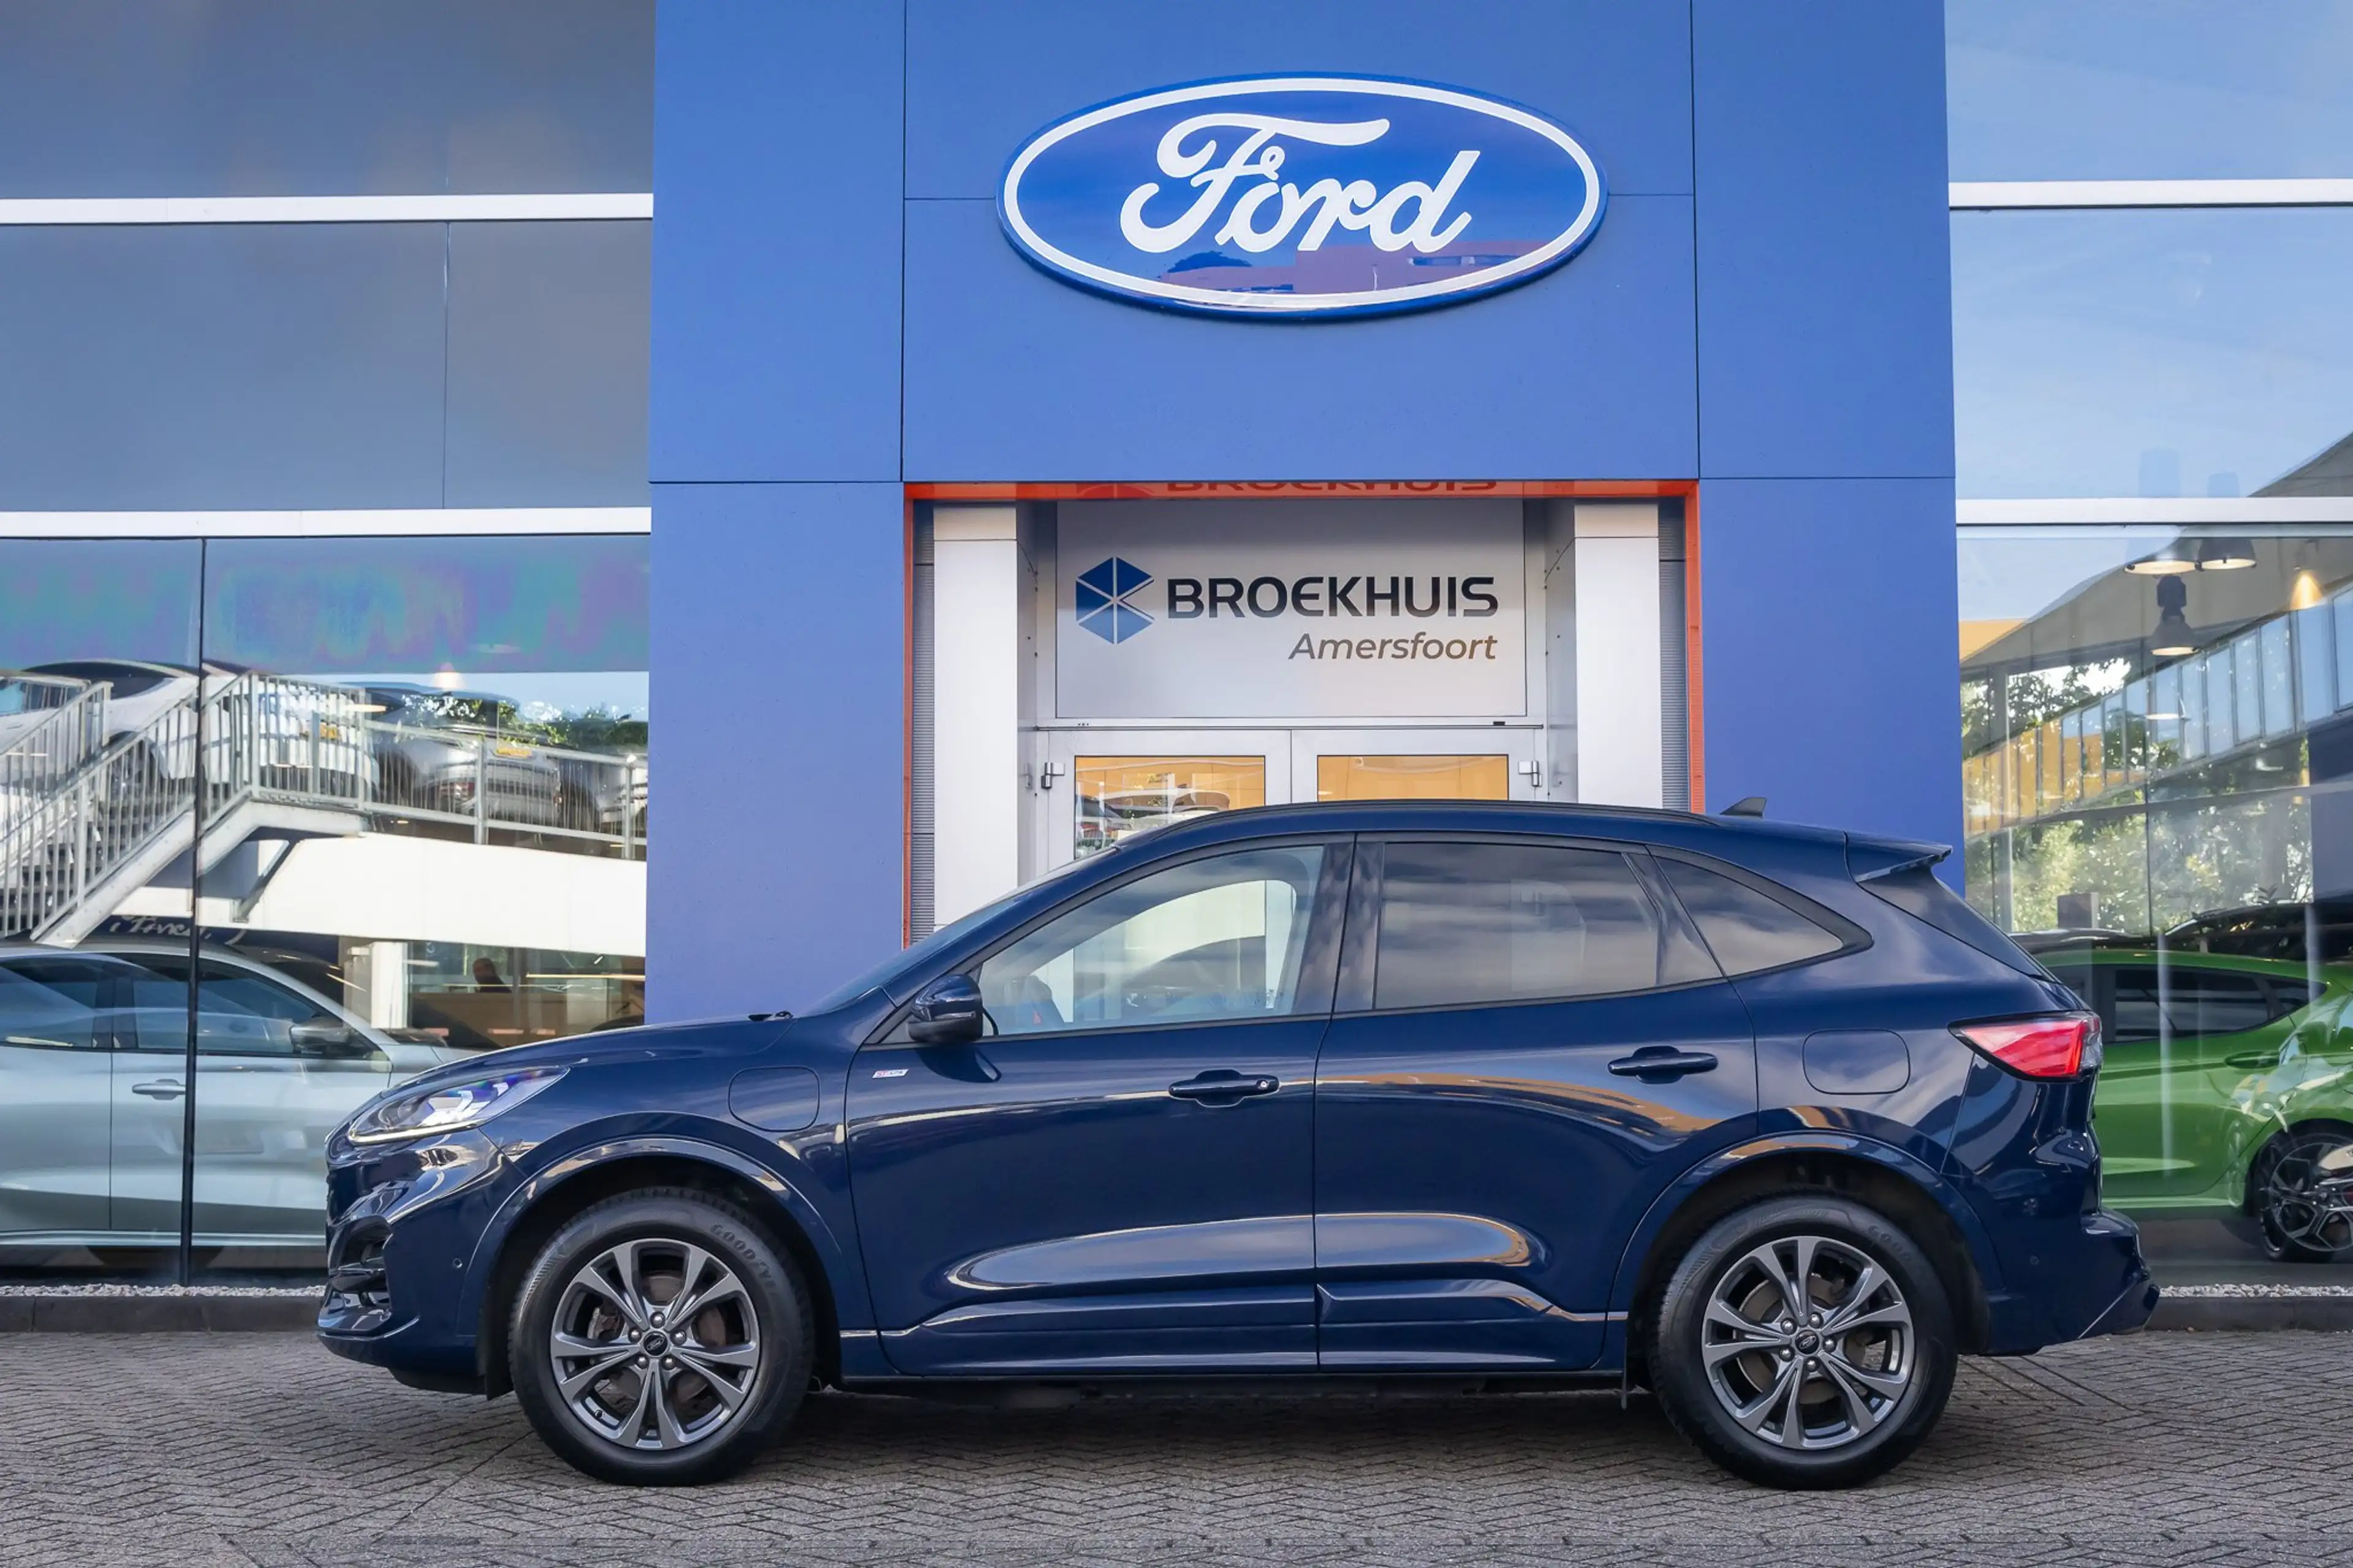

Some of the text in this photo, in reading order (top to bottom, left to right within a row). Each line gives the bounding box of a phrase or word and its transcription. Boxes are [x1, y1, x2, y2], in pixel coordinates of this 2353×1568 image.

[1120, 112, 1480, 253] Ford
[1167, 575, 1499, 619] BROEKHUIS
[1288, 631, 1498, 660] Amersfoort
